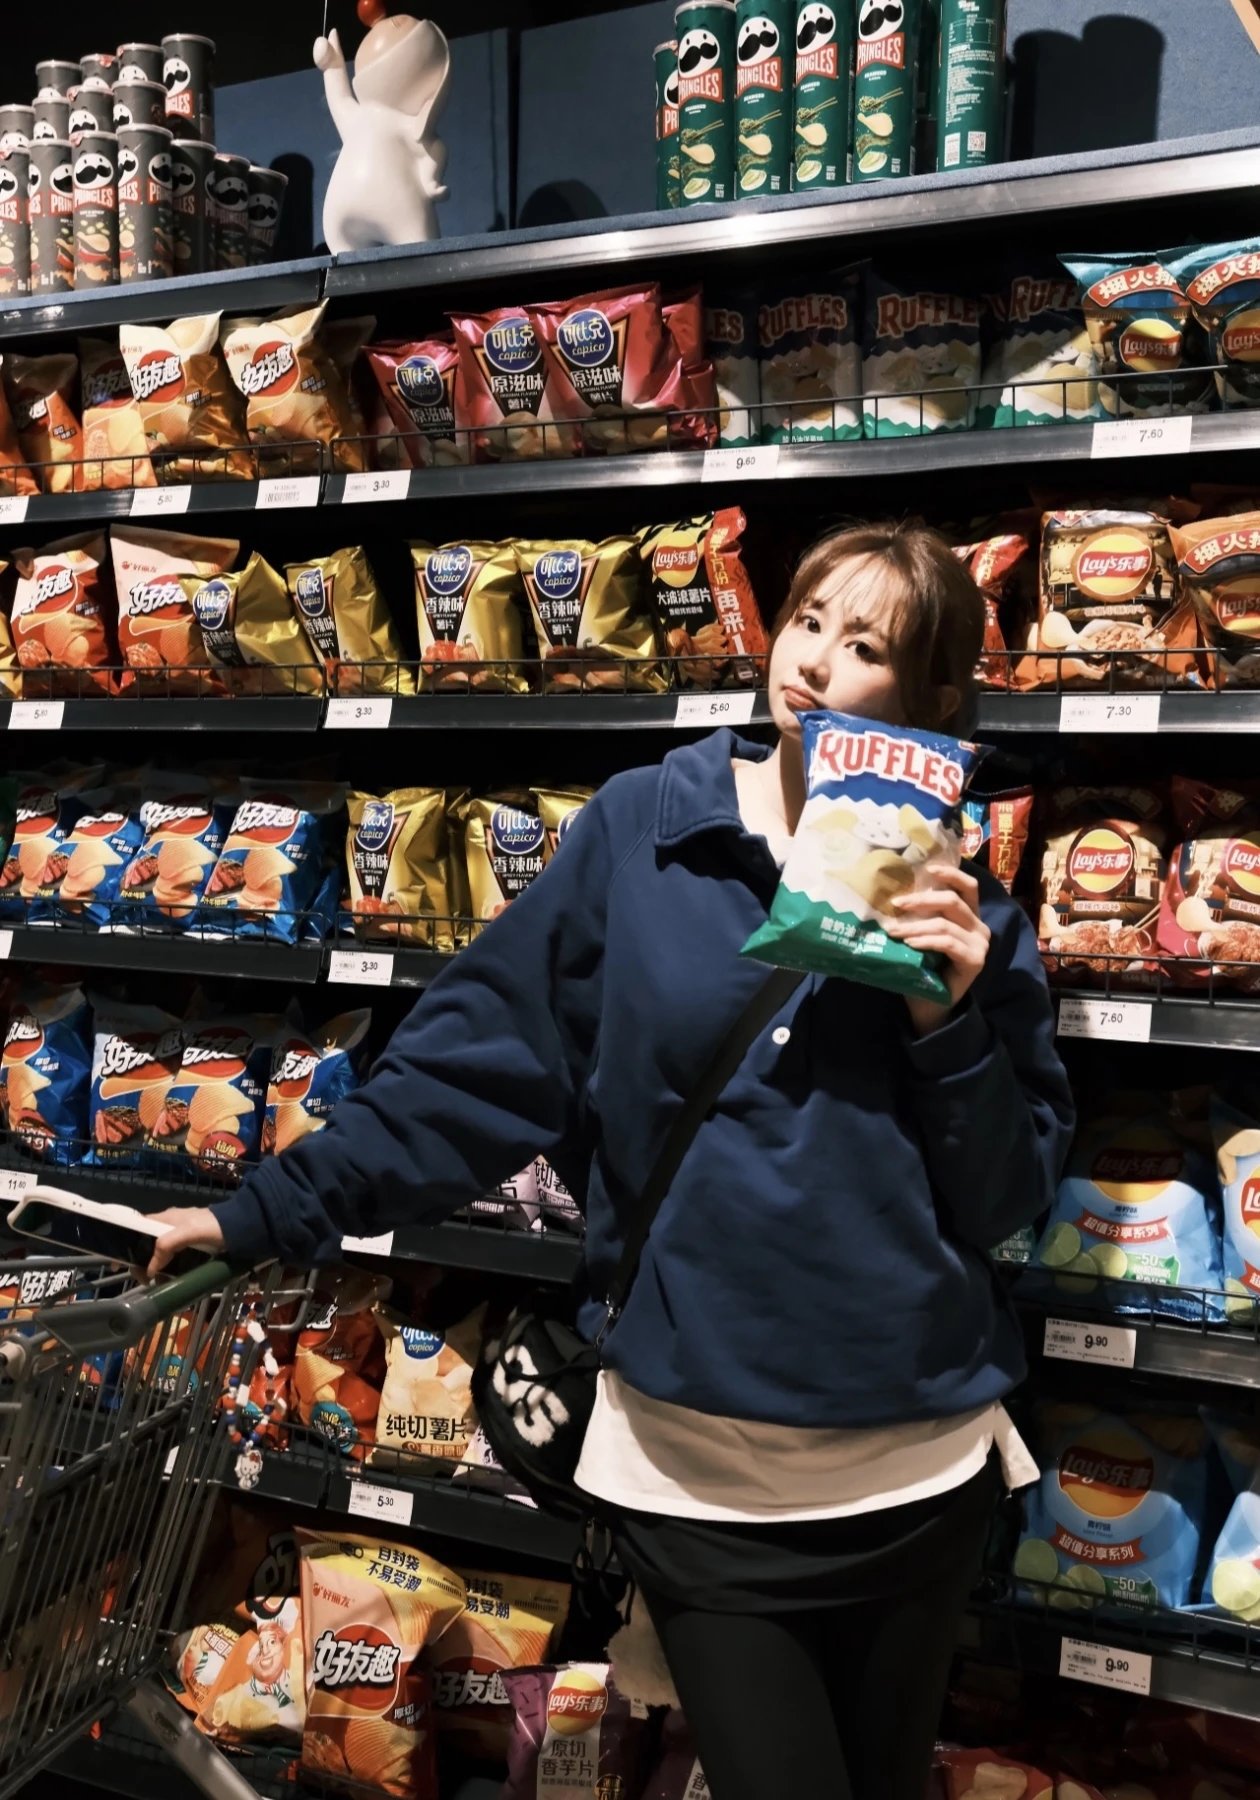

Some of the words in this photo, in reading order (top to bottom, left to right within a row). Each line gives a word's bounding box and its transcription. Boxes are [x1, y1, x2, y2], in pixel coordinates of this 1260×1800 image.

[857, 37, 902, 71] PRINGLES
[737, 61, 778, 93] PRINGLES
[759, 293, 847, 347] RUFFLES
[491, 325, 536, 350] 可比克
[563, 318, 606, 345] 可比克
[498, 350, 533, 363] copico
[572, 343, 605, 357] copico
[131, 354, 182, 401] 好友趣
[241, 342, 294, 396] 好友趣
[570, 365, 622, 388] 原滋味
[491, 373, 544, 393] 原滋味
[411, 407, 454, 423] 原滋味
[1139, 429, 1163, 442] 7.60
[736, 457, 756, 469] 9.60
[373, 480, 390, 492] 3.30
[431, 553, 466, 576] 可比克
[540, 556, 576, 579] 可比克
[434, 573, 461, 585] copico
[544, 577, 573, 589] copico
[426, 597, 464, 614] 香辣味
[657, 587, 711, 606] 大波浪薯片
[538, 601, 581, 619] 香辣味
[304, 616, 336, 636] 香辣味
[356, 706, 373, 718] 3.30
[709, 703, 730, 715] 5.60
[1106, 706, 1132, 718] 7.30
[818, 732, 961, 804] RUFFLES
[360, 829, 383, 841] copico
[502, 831, 535, 845] copico
[354, 852, 389, 869] 香辣味
[493, 857, 543, 873] 香辣味
[361, 960, 378, 972] 3.30
[1100, 1012, 1123, 1026] 7.60
[1084, 1216, 1160, 1239] 超值分享系列
[408, 1342, 434, 1354] copico
[1084, 1333, 1108, 1350] 9.90
[386, 1413, 466, 1441] 纯切薯片
[377, 1495, 394, 1508] 5.30
[1059, 1533, 1134, 1561] 超值分享系列
[377, 1545, 421, 1572] 自封袋
[365, 1559, 423, 1593] 不易受潮
[323, 1588, 350, 1608] 好丽友
[313, 1630, 401, 1688] 好友趣
[1105, 1657, 1129, 1673] 9.90
[550, 1739, 586, 1758] 原切
[541, 1758, 595, 1777] 香芋片
